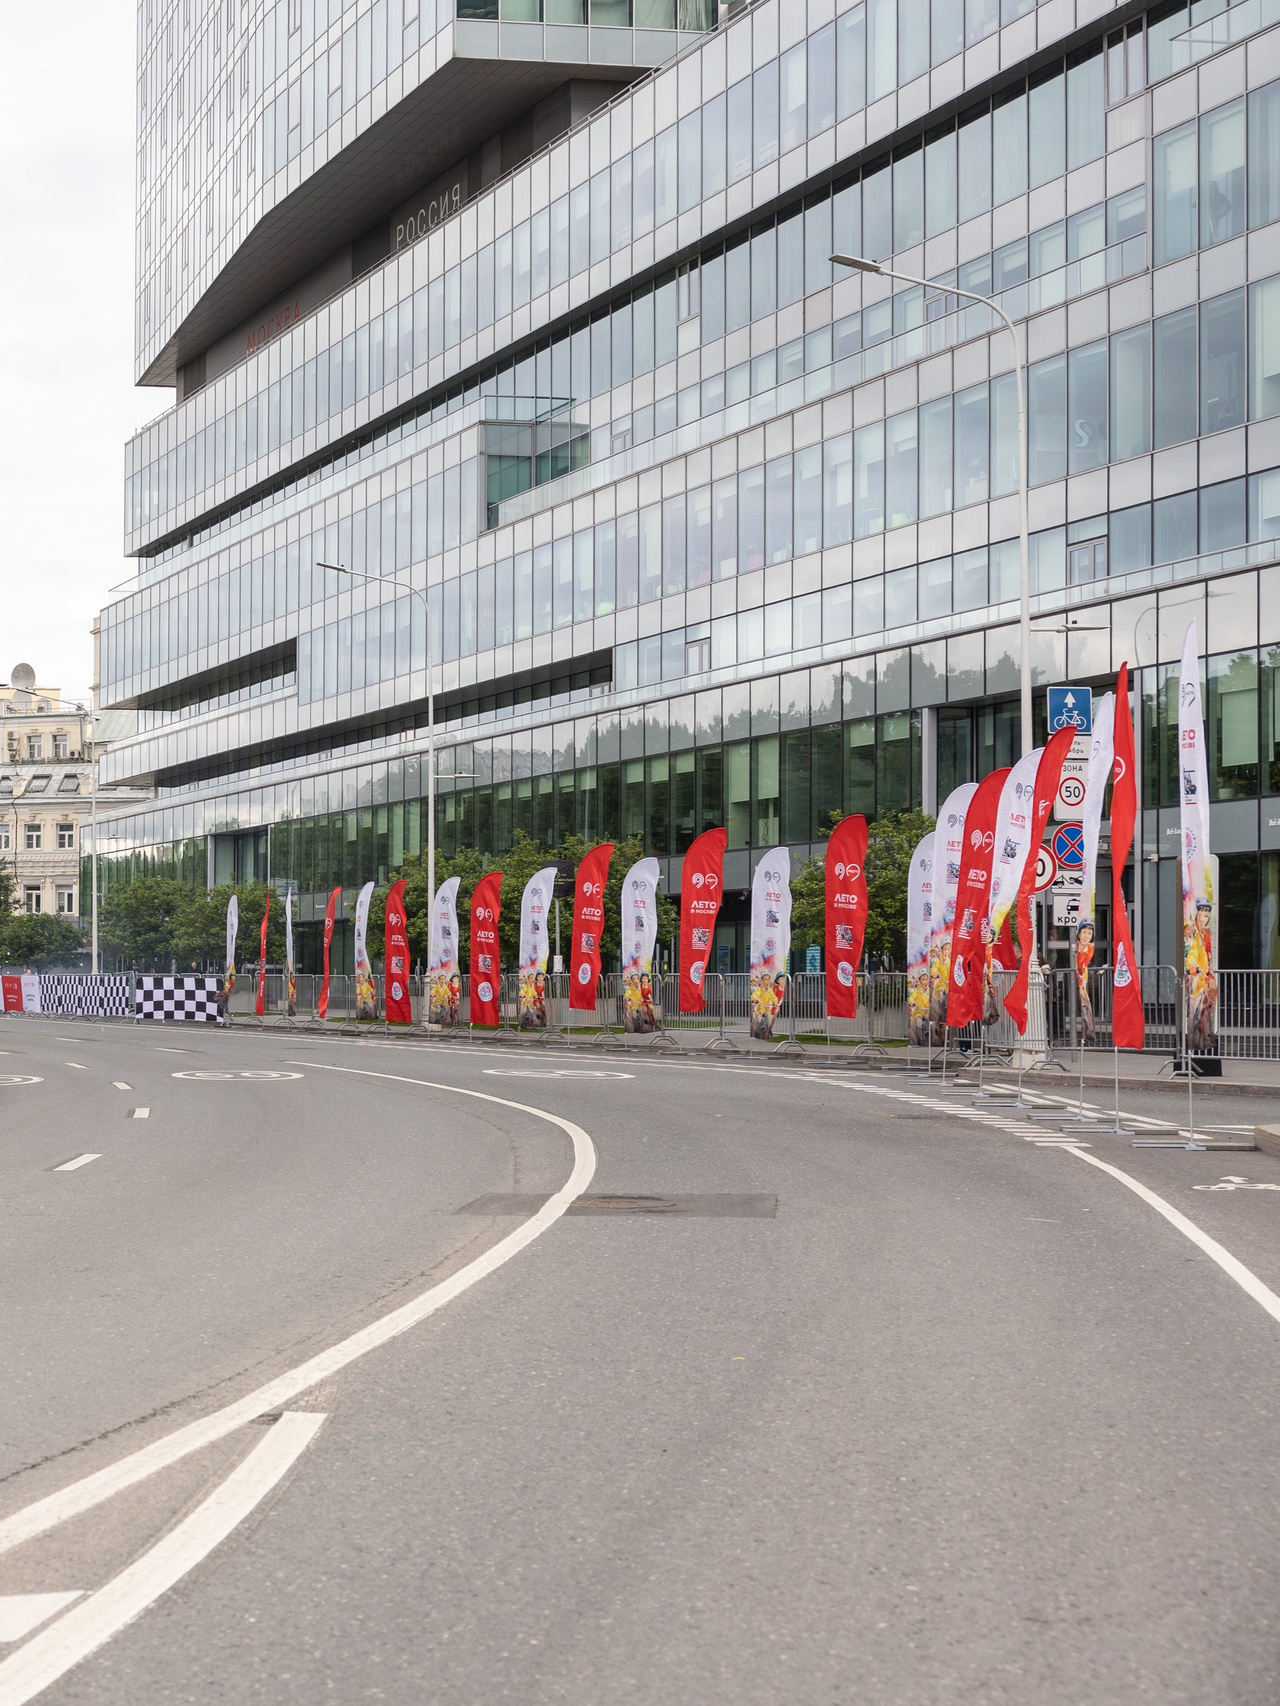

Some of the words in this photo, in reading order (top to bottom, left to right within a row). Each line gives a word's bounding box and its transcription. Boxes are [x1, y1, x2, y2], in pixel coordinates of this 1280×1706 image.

[396, 183, 461, 251] РОССИЯ
[1065, 786, 1081, 798] 50
[834, 893, 858, 904] ЛЕТО
[691, 900, 717, 909] ЛЕТО
[581, 907, 602, 917] ЛЕТО
[1057, 916, 1078, 928] кро
[477, 930, 495, 939] ЛЕТО
